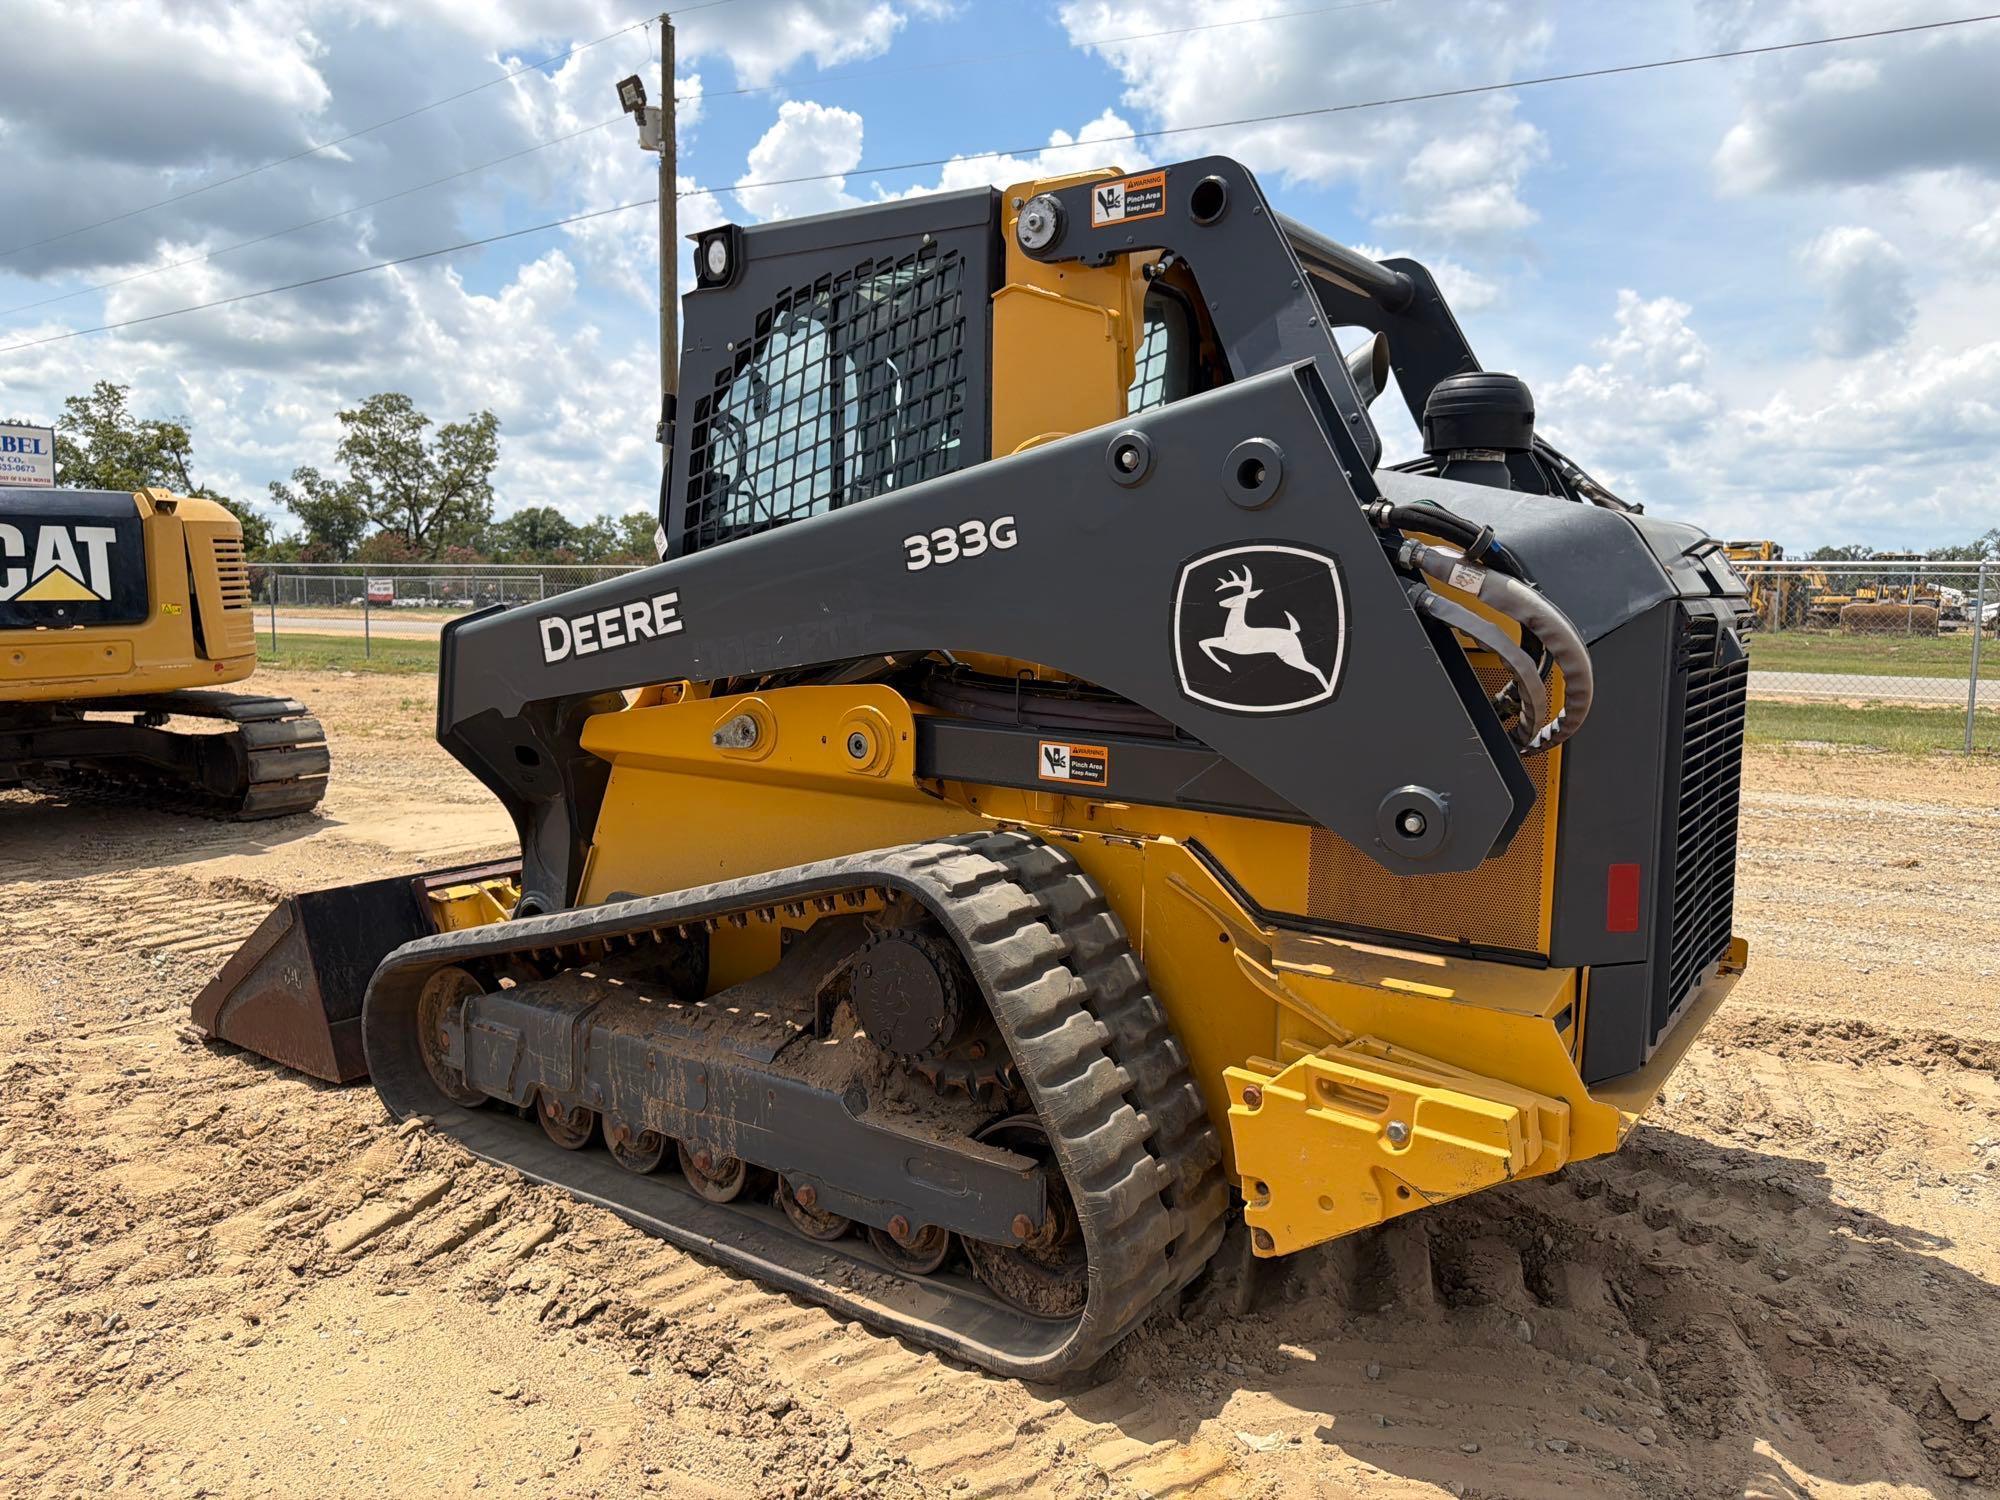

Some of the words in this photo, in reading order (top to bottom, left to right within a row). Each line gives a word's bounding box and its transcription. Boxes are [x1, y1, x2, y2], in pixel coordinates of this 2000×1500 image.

[1133, 177, 1161, 187] WARNING
[1126, 195, 1145, 204] Pinch
[1145, 192, 1160, 200] Area
[0, 435, 48, 456] BEL
[903, 516, 1018, 571] 333G
[0, 523, 117, 601] CAT
[539, 591, 683, 663] DEERE
[1078, 748, 1104, 756] WARNING
[1071, 761, 1088, 769] Pinch
